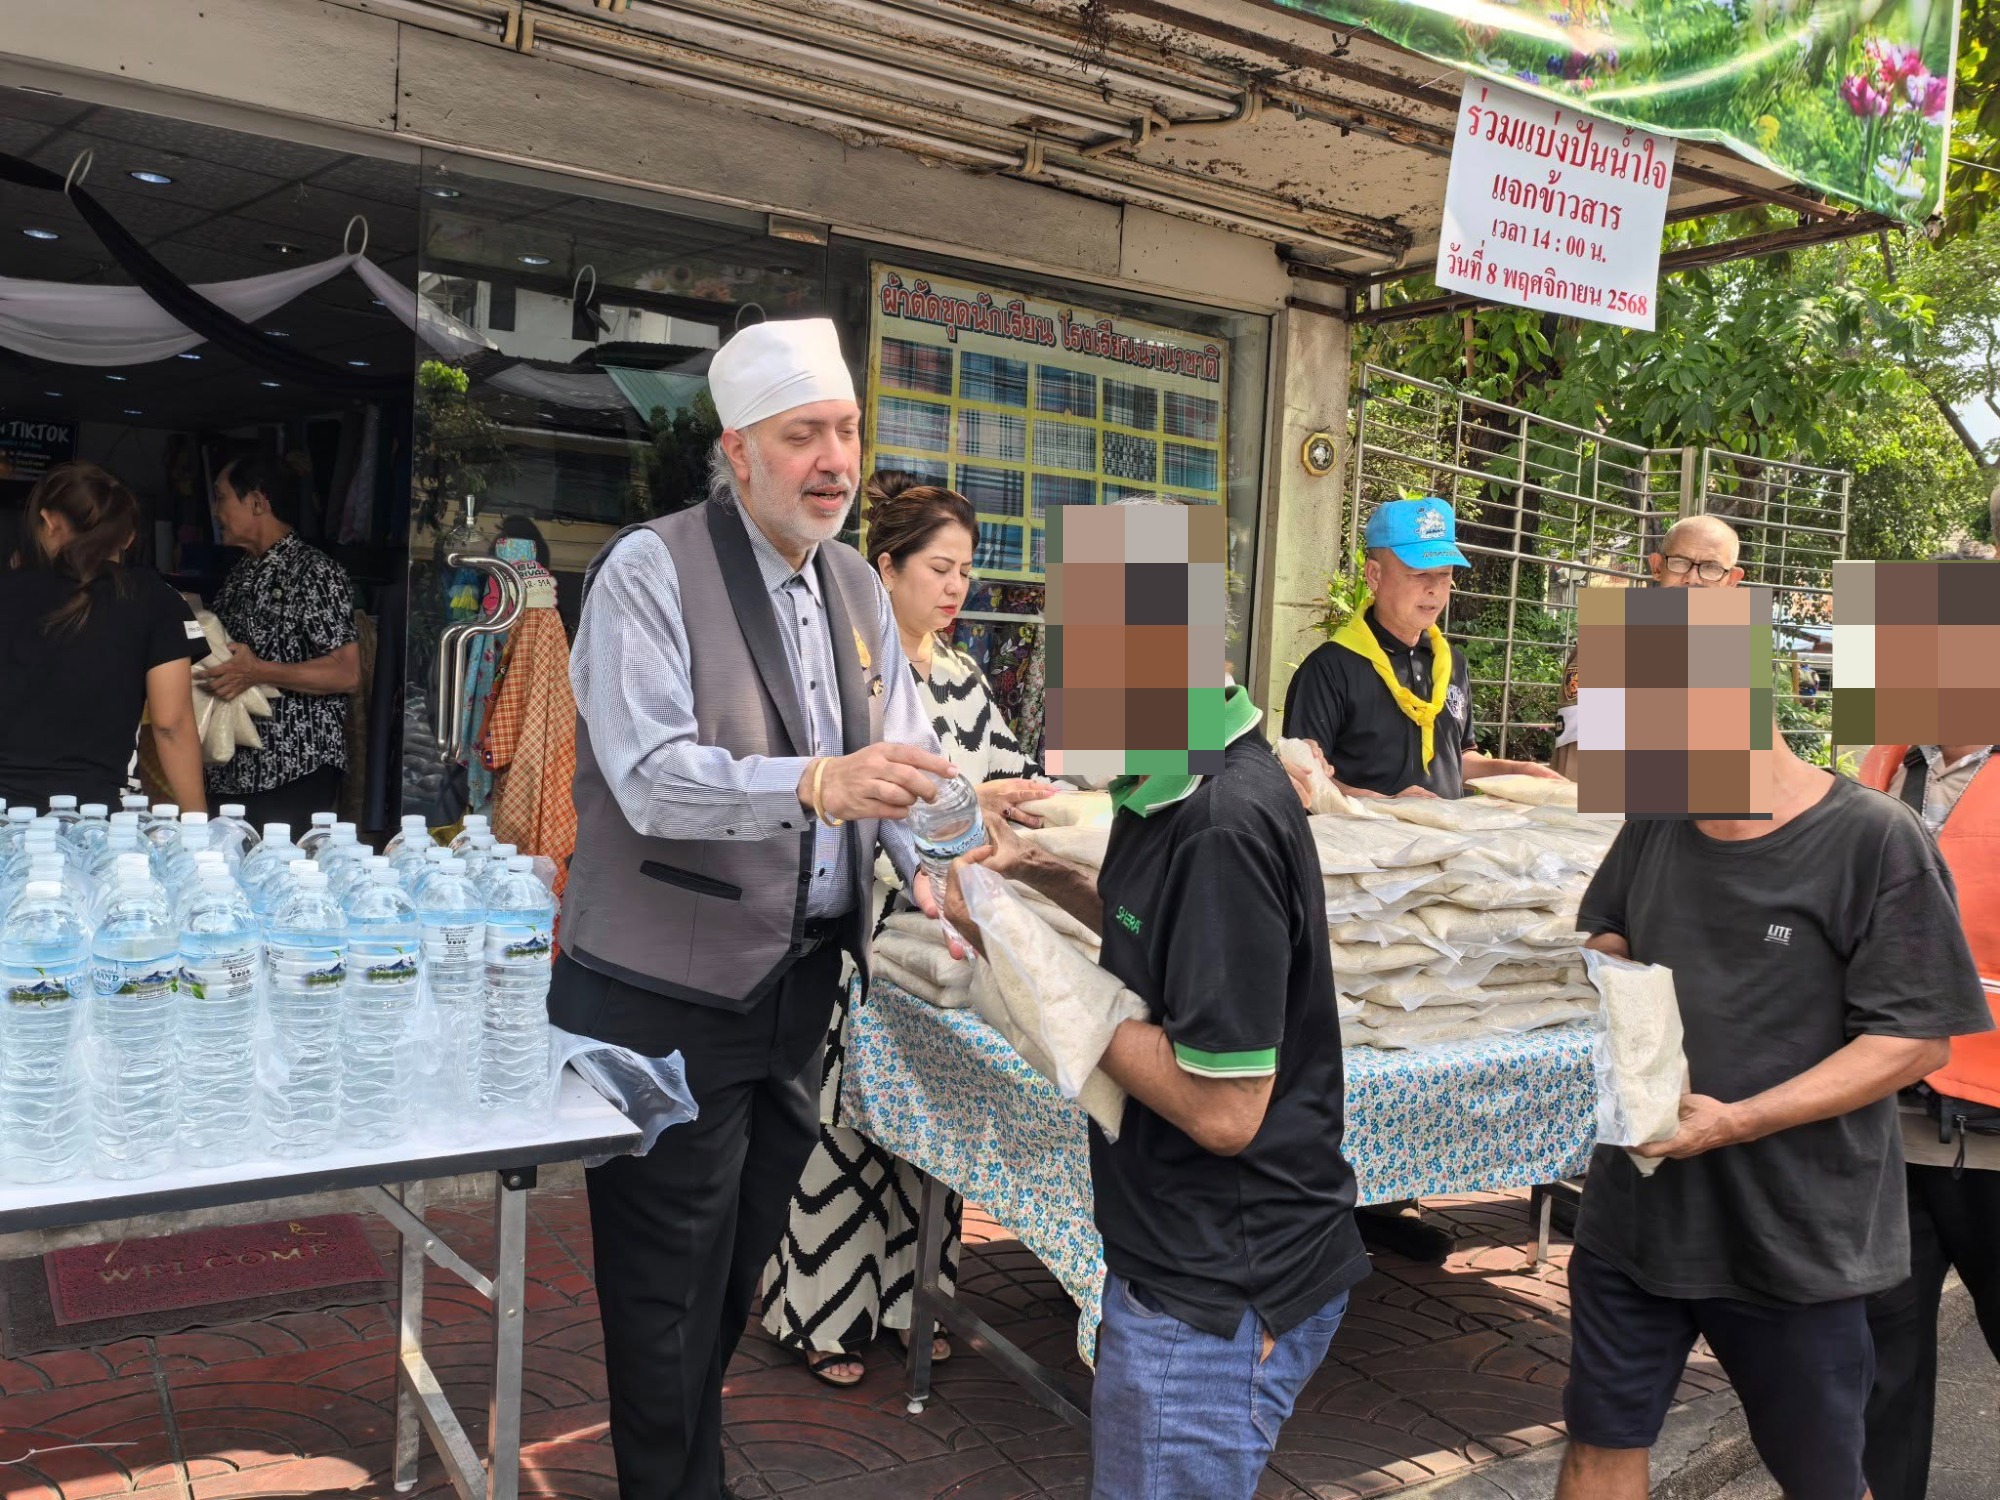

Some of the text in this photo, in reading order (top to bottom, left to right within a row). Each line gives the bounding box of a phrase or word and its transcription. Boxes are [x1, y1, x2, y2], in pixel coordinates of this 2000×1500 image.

[1467, 87, 1668, 190] ร่วมแบ่งปันน้ำใจ
[1491, 169, 1622, 231] แจกข้าวสาร
[1491, 218, 1527, 244] เวลา
[1590, 242, 1607, 263] น.
[1447, 239, 1649, 316] วันที่ 8 พฤศจิกายน 2568
[881, 272, 1056, 348] ผ้าตัดชุดนักเรียน
[9, 420, 70, 444] TIKTOK
[518, 563, 536, 571] EW
[518, 569, 547, 577] RIVAL
[1115, 905, 1144, 935] SHERA
[1767, 923, 1793, 940] LITE
